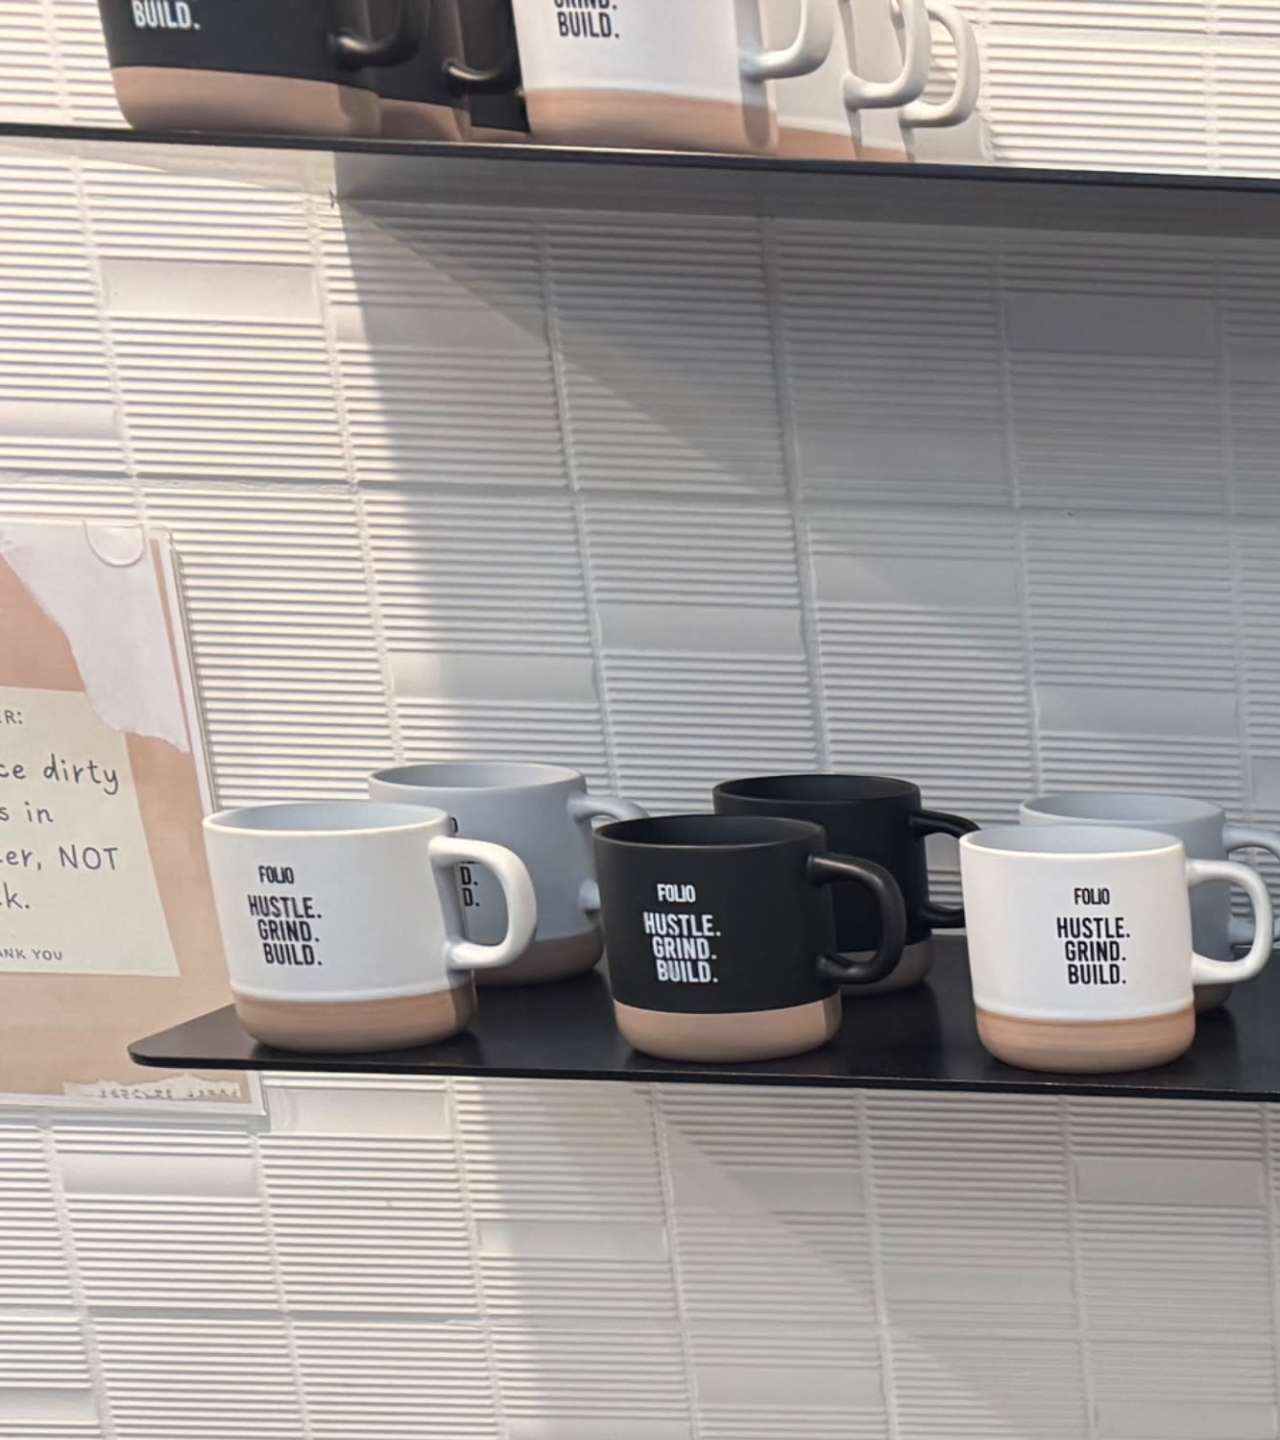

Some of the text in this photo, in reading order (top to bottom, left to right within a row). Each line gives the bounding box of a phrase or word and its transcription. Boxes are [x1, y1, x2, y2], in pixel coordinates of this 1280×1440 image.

[131, 0, 200, 30] BUILD.
[557, 11, 619, 39] BUILD.
[0, 709, 23, 725] R:
[43, 753, 119, 796] dirty
[24, 801, 54, 823] in
[58, 845, 118, 871] NOT
[259, 865, 294, 884] FOLIO
[0, 882, 30, 909] k.
[657, 883, 696, 903] FOLIO
[1074, 888, 1110, 905] FOLIO
[248, 895, 322, 918] HUSTLE.
[258, 919, 320, 942] GRIND.
[643, 912, 721, 937] HUSTLE.
[1056, 917, 1130, 938] HUSTLE.
[32, 948, 62, 961] YOU
[263, 943, 323, 965] BUILD.
[652, 936, 717, 960] GRIND.
[1065, 940, 1126, 962] GRIND.
[656, 960, 718, 983] BUILD.
[1068, 964, 1126, 985] BUILD.
